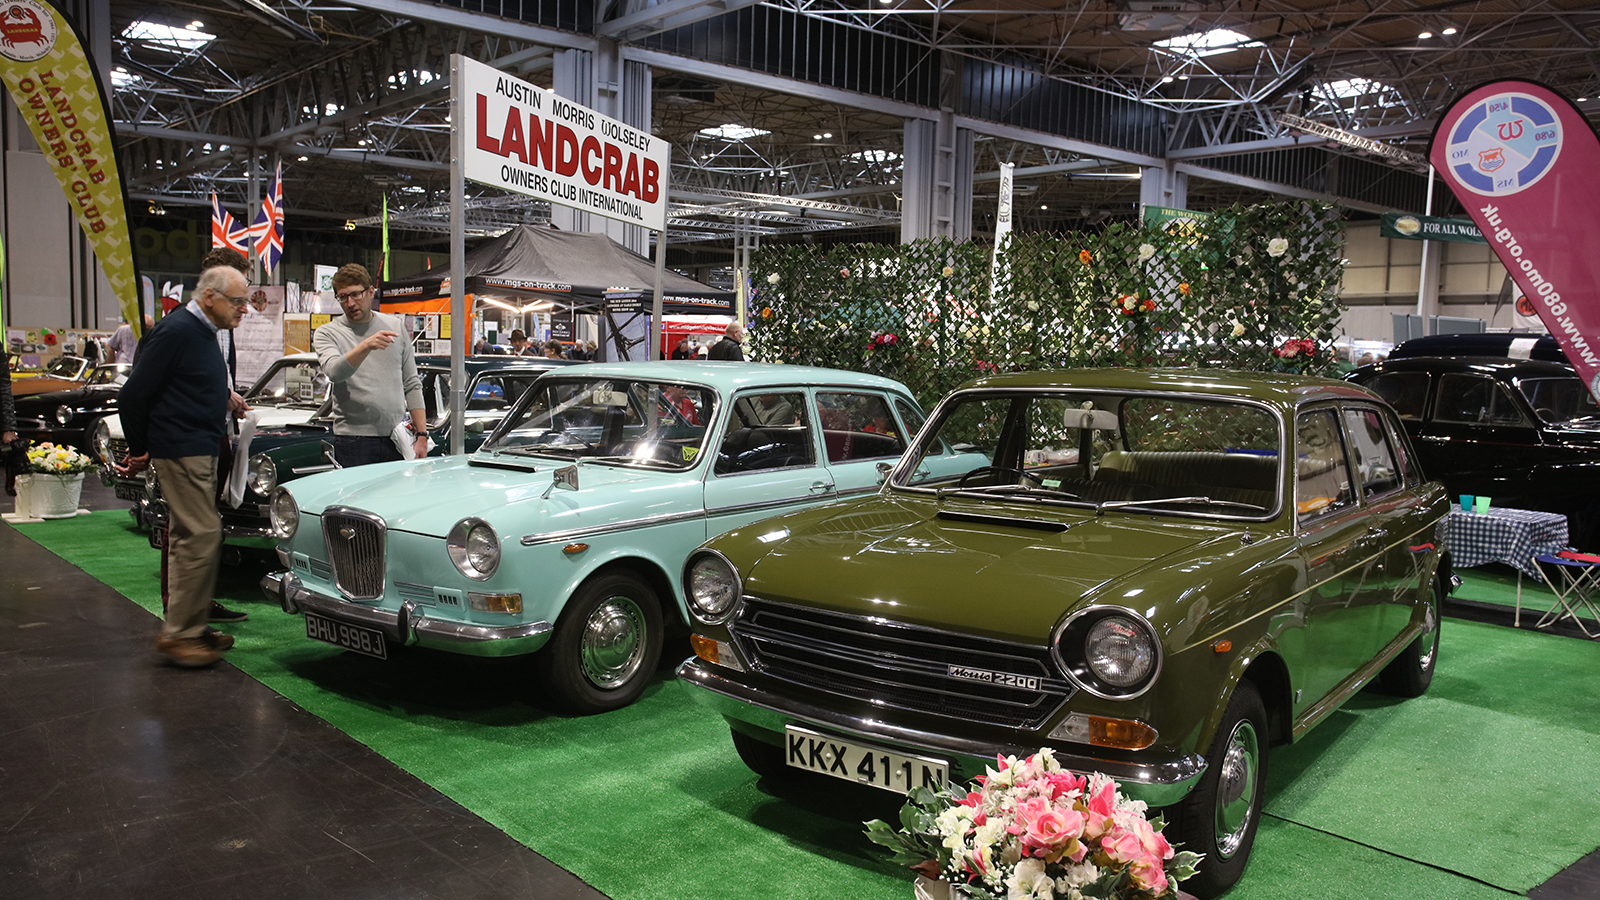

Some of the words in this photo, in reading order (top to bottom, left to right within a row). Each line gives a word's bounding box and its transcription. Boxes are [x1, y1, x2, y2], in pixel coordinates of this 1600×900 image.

[38, 70, 105, 184] LANDCRAB
[496, 77, 541, 109] AUSTIN
[553, 99, 595, 130] MORRIS
[601, 119, 650, 152] WOLSELEY
[19, 78, 78, 171] OWNERS'
[72, 180, 106, 234] CLUB
[476, 92, 660, 204] LANDCRAB
[501, 165, 548, 193] OWNERS
[550, 180, 576, 200] CLUB
[579, 188, 643, 220] INTERNATIONAL
[1161, 208, 1176, 217] THE
[1423, 222, 1440, 233] FOR
[1441, 224, 1458, 235] ALL
[485, 277, 572, 292] www.mgs-on-track.com
[307, 615, 338, 643] BHU
[340, 625, 383, 655] 998J
[951, 667, 991, 681] Morris
[994, 673, 1037, 690] 2200
[788, 734, 849, 776] KKX
[856, 751, 943, 793] 411N
